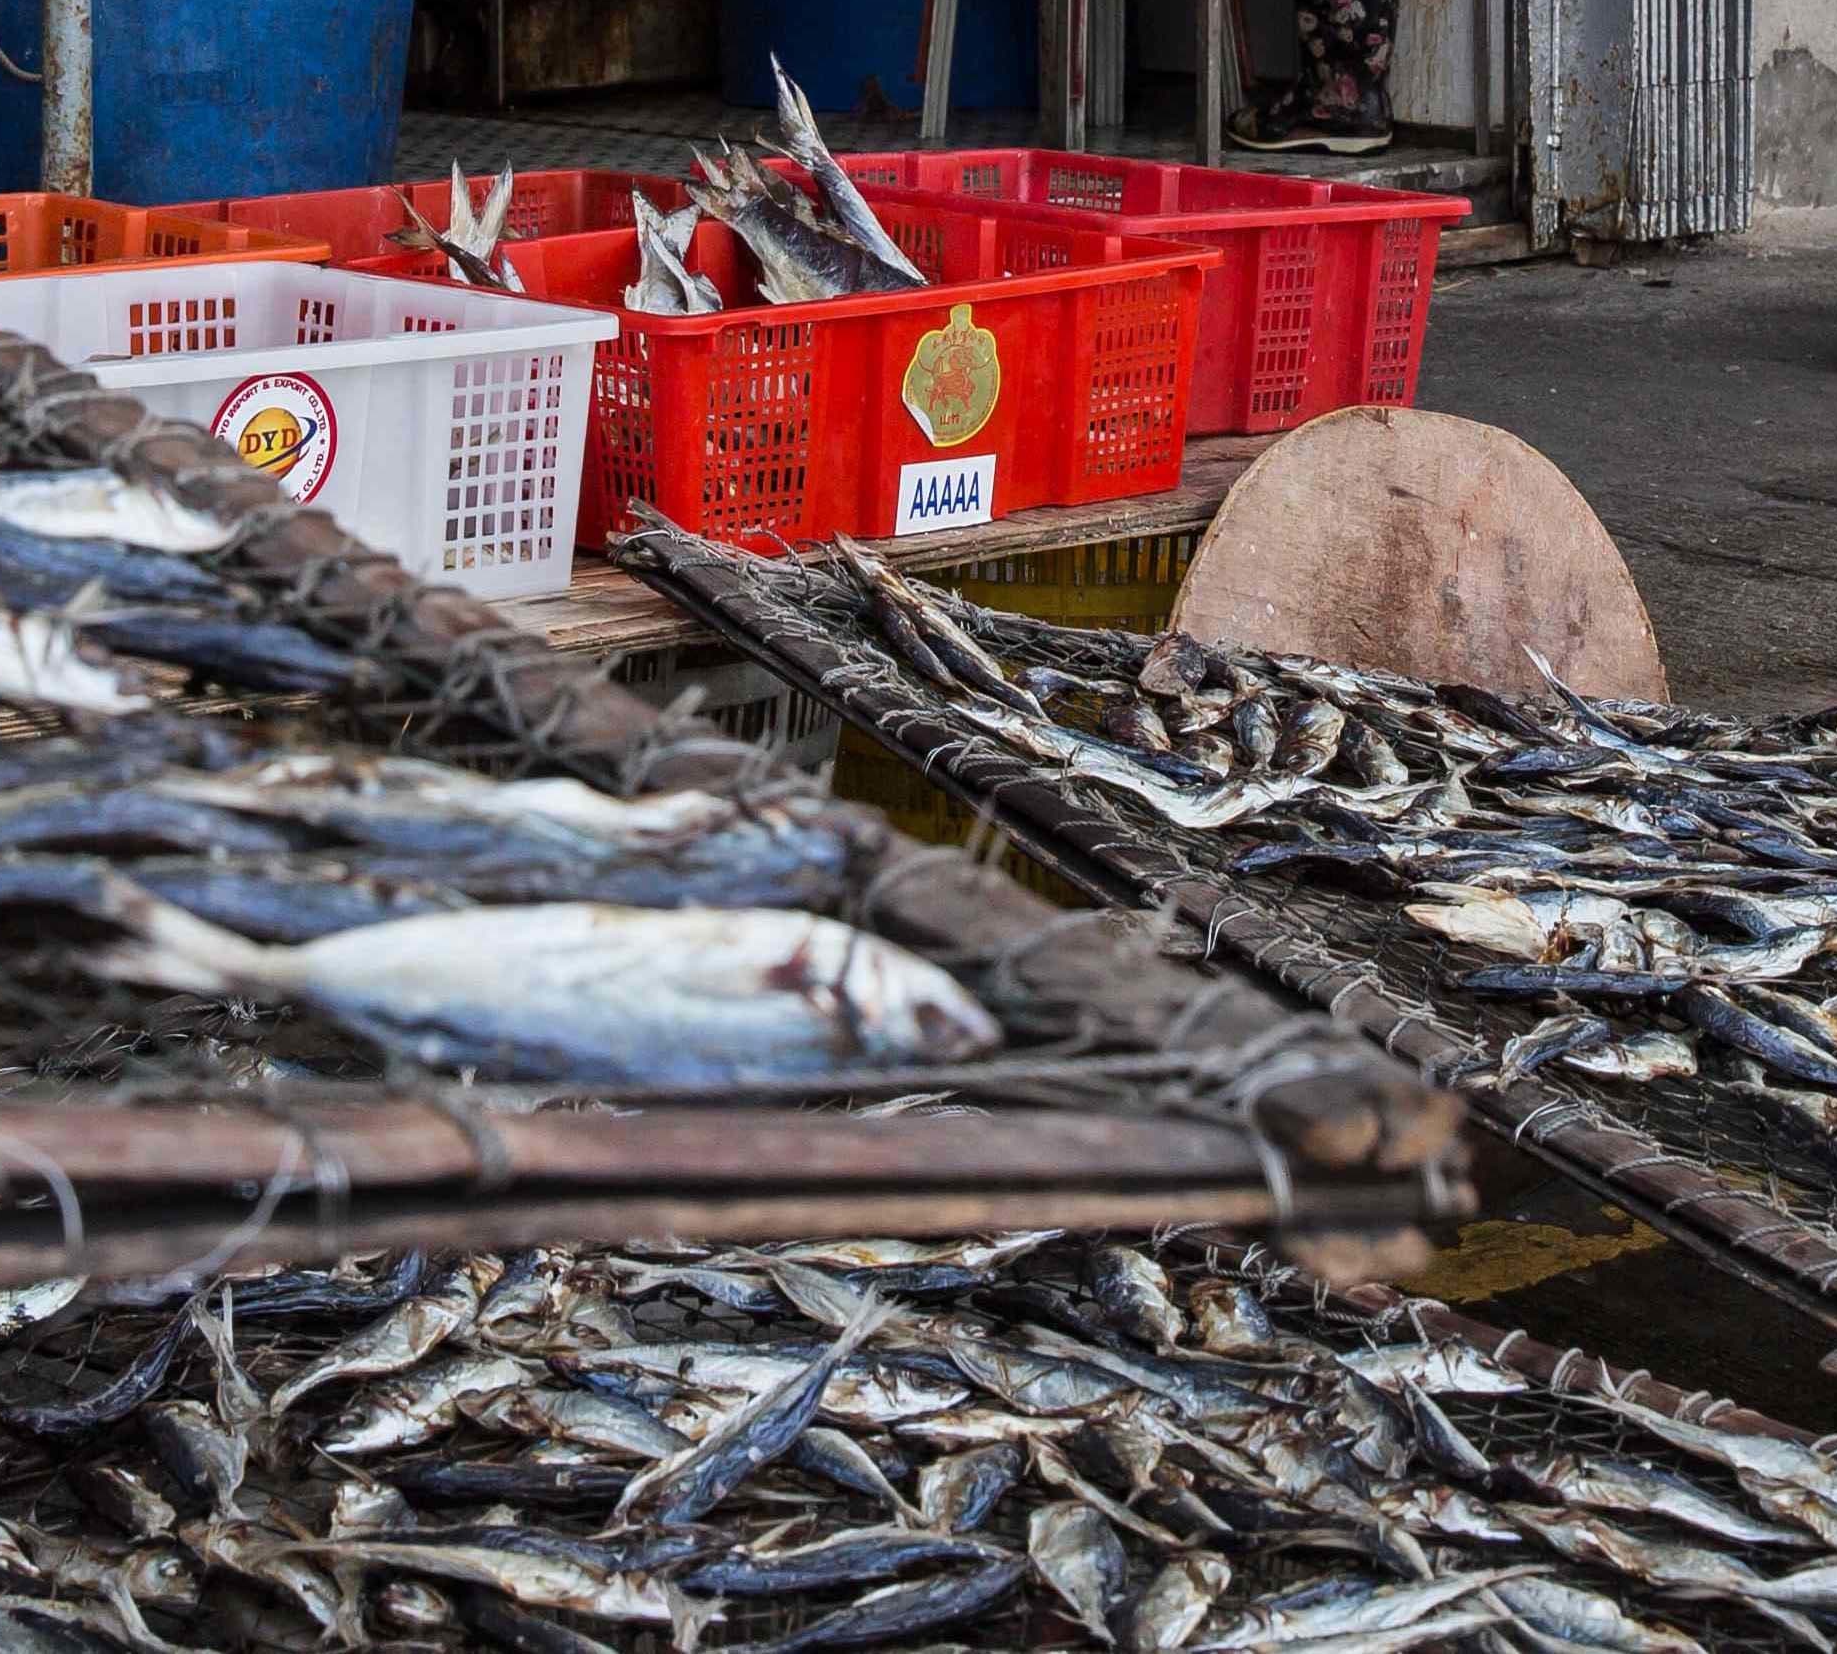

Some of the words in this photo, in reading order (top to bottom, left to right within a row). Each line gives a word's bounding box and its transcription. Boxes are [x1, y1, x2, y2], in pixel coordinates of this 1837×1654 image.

[229, 385, 258, 418] IMPORT
[262, 381, 270, 390] &
[274, 379, 309, 395] EXPORT
[244, 428, 298, 454] DYD
[909, 471, 980, 520] AAAAA
